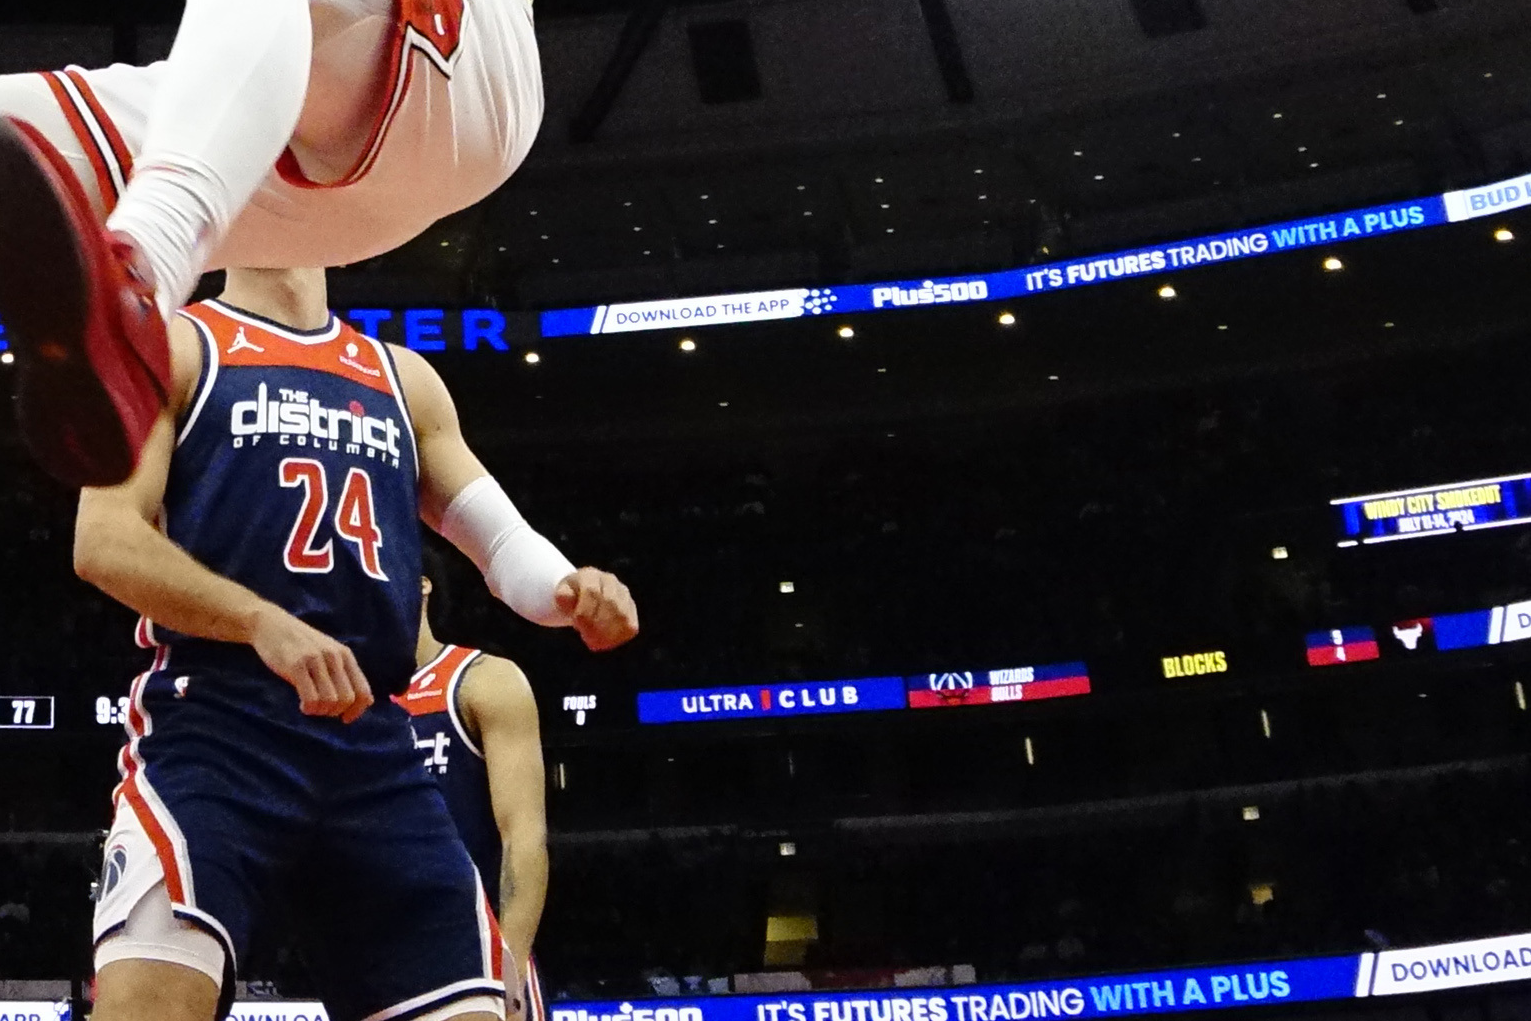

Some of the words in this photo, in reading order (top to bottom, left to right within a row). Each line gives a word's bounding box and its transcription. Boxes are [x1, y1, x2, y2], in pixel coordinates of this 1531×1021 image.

[1470, 186, 1520, 211] BUD
[1025, 268, 1064, 292] IT'S
[1066, 250, 1166, 284] FUTURES
[1166, 232, 1269, 269] TRADING
[1271, 220, 1340, 249] WITH
[1343, 216, 1362, 237] A
[1364, 205, 1425, 232] PLUS
[872, 279, 988, 309] Plus500
[615, 304, 717, 325] DOWNLOAD
[721, 301, 752, 319] THE
[755, 297, 790, 315] APP
[278, 387, 310, 404] THE
[230, 381, 401, 459] district
[233, 434, 262, 450] OF
[278, 434, 400, 469] COLUMBIA
[1406, 493, 1435, 515] CITY
[1435, 484, 1502, 511] SMOKEOUT
[278, 457, 390, 583] 24
[1162, 651, 1228, 678] BLOCKS
[11, 700, 36, 724] 77
[96, 696, 129, 724] 9:3
[563, 694, 597, 711] FOULS
[682, 693, 753, 713] ULTRA
[778, 685, 860, 709] CLUB
[1391, 946, 1531, 983] DOWNLOAD
[813, 995, 949, 1021] FUTURES
[950, 988, 1085, 1021] TRADING
[1089, 978, 1175, 1014] WITH
[1183, 978, 1207, 1006] A
[1211, 970, 1291, 1003] PLUS
